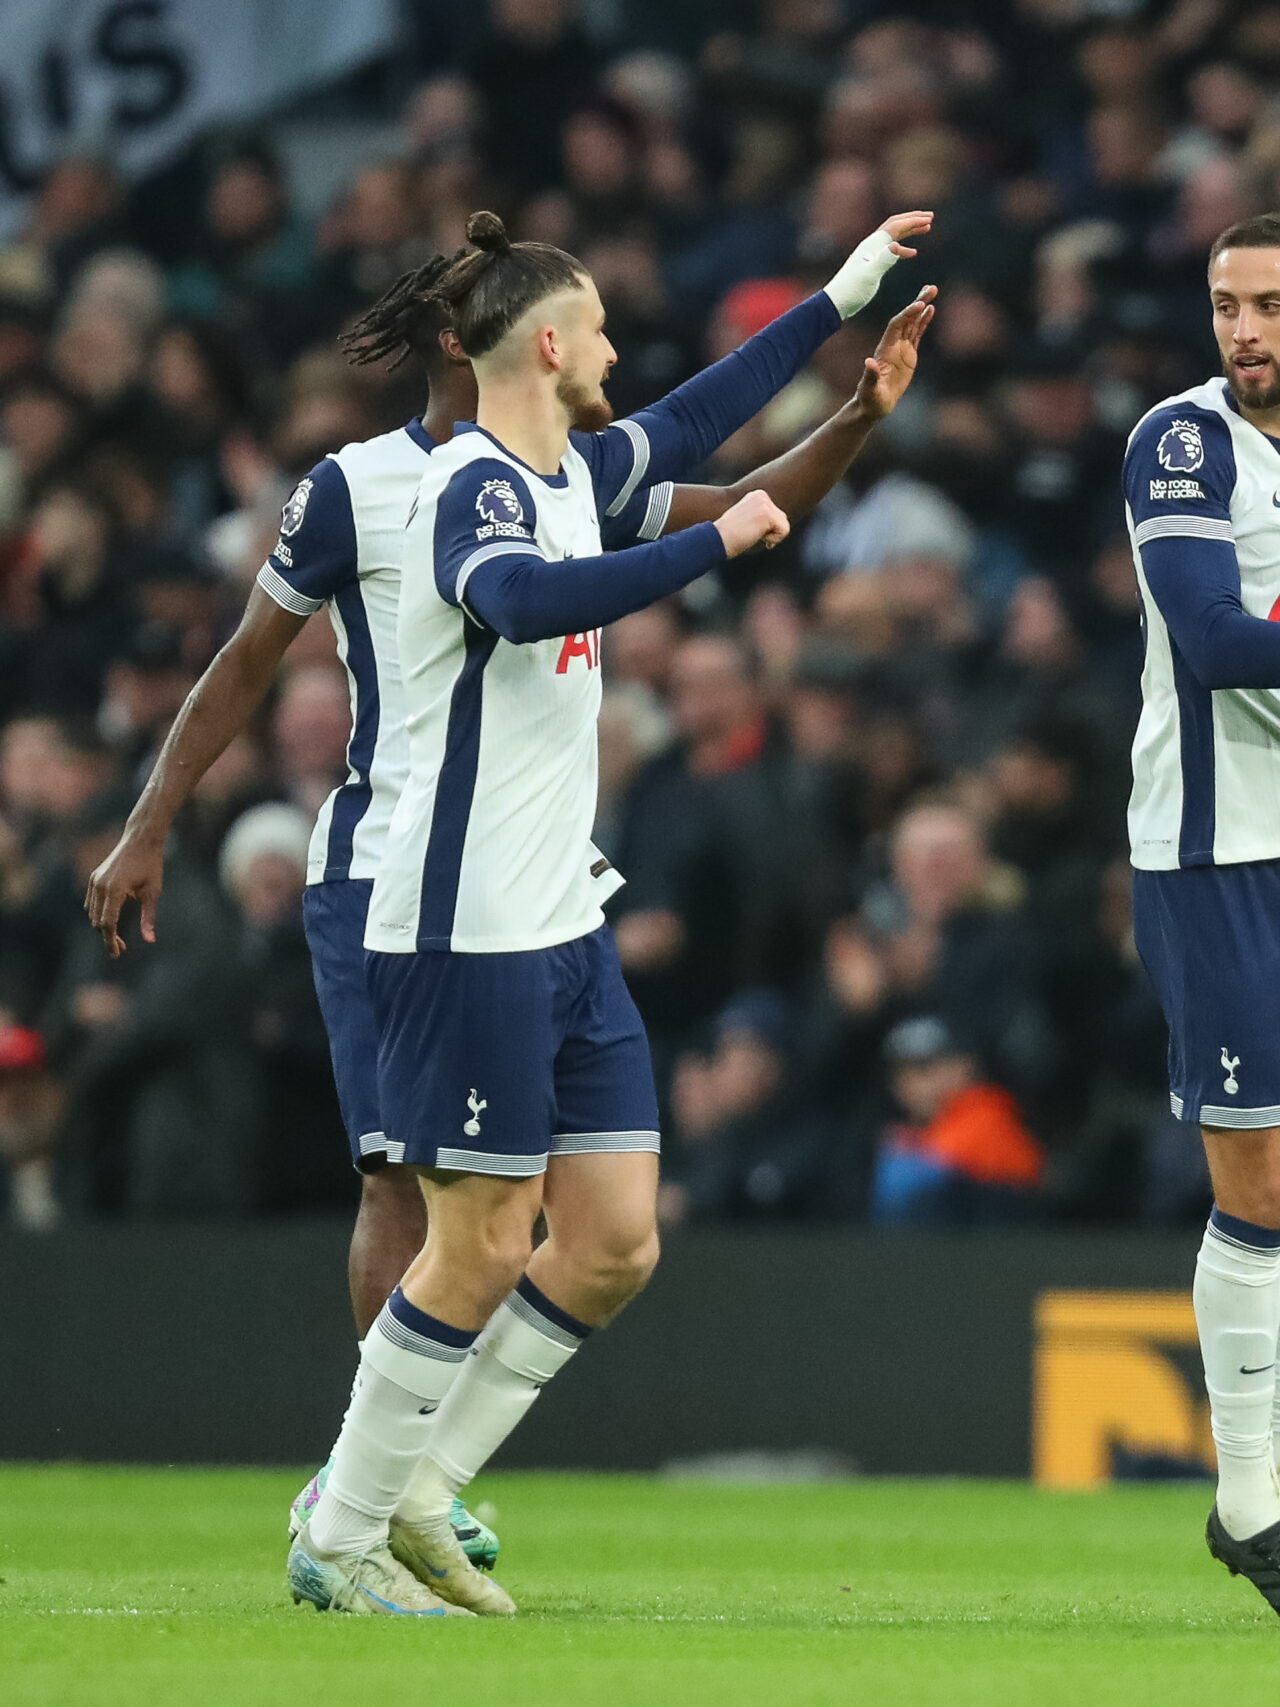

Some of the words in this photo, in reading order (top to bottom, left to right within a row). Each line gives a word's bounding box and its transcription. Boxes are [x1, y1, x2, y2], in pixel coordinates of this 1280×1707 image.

[1150, 479, 1167, 490] No
[1168, 480, 1199, 490] room
[1150, 489, 1166, 500] for
